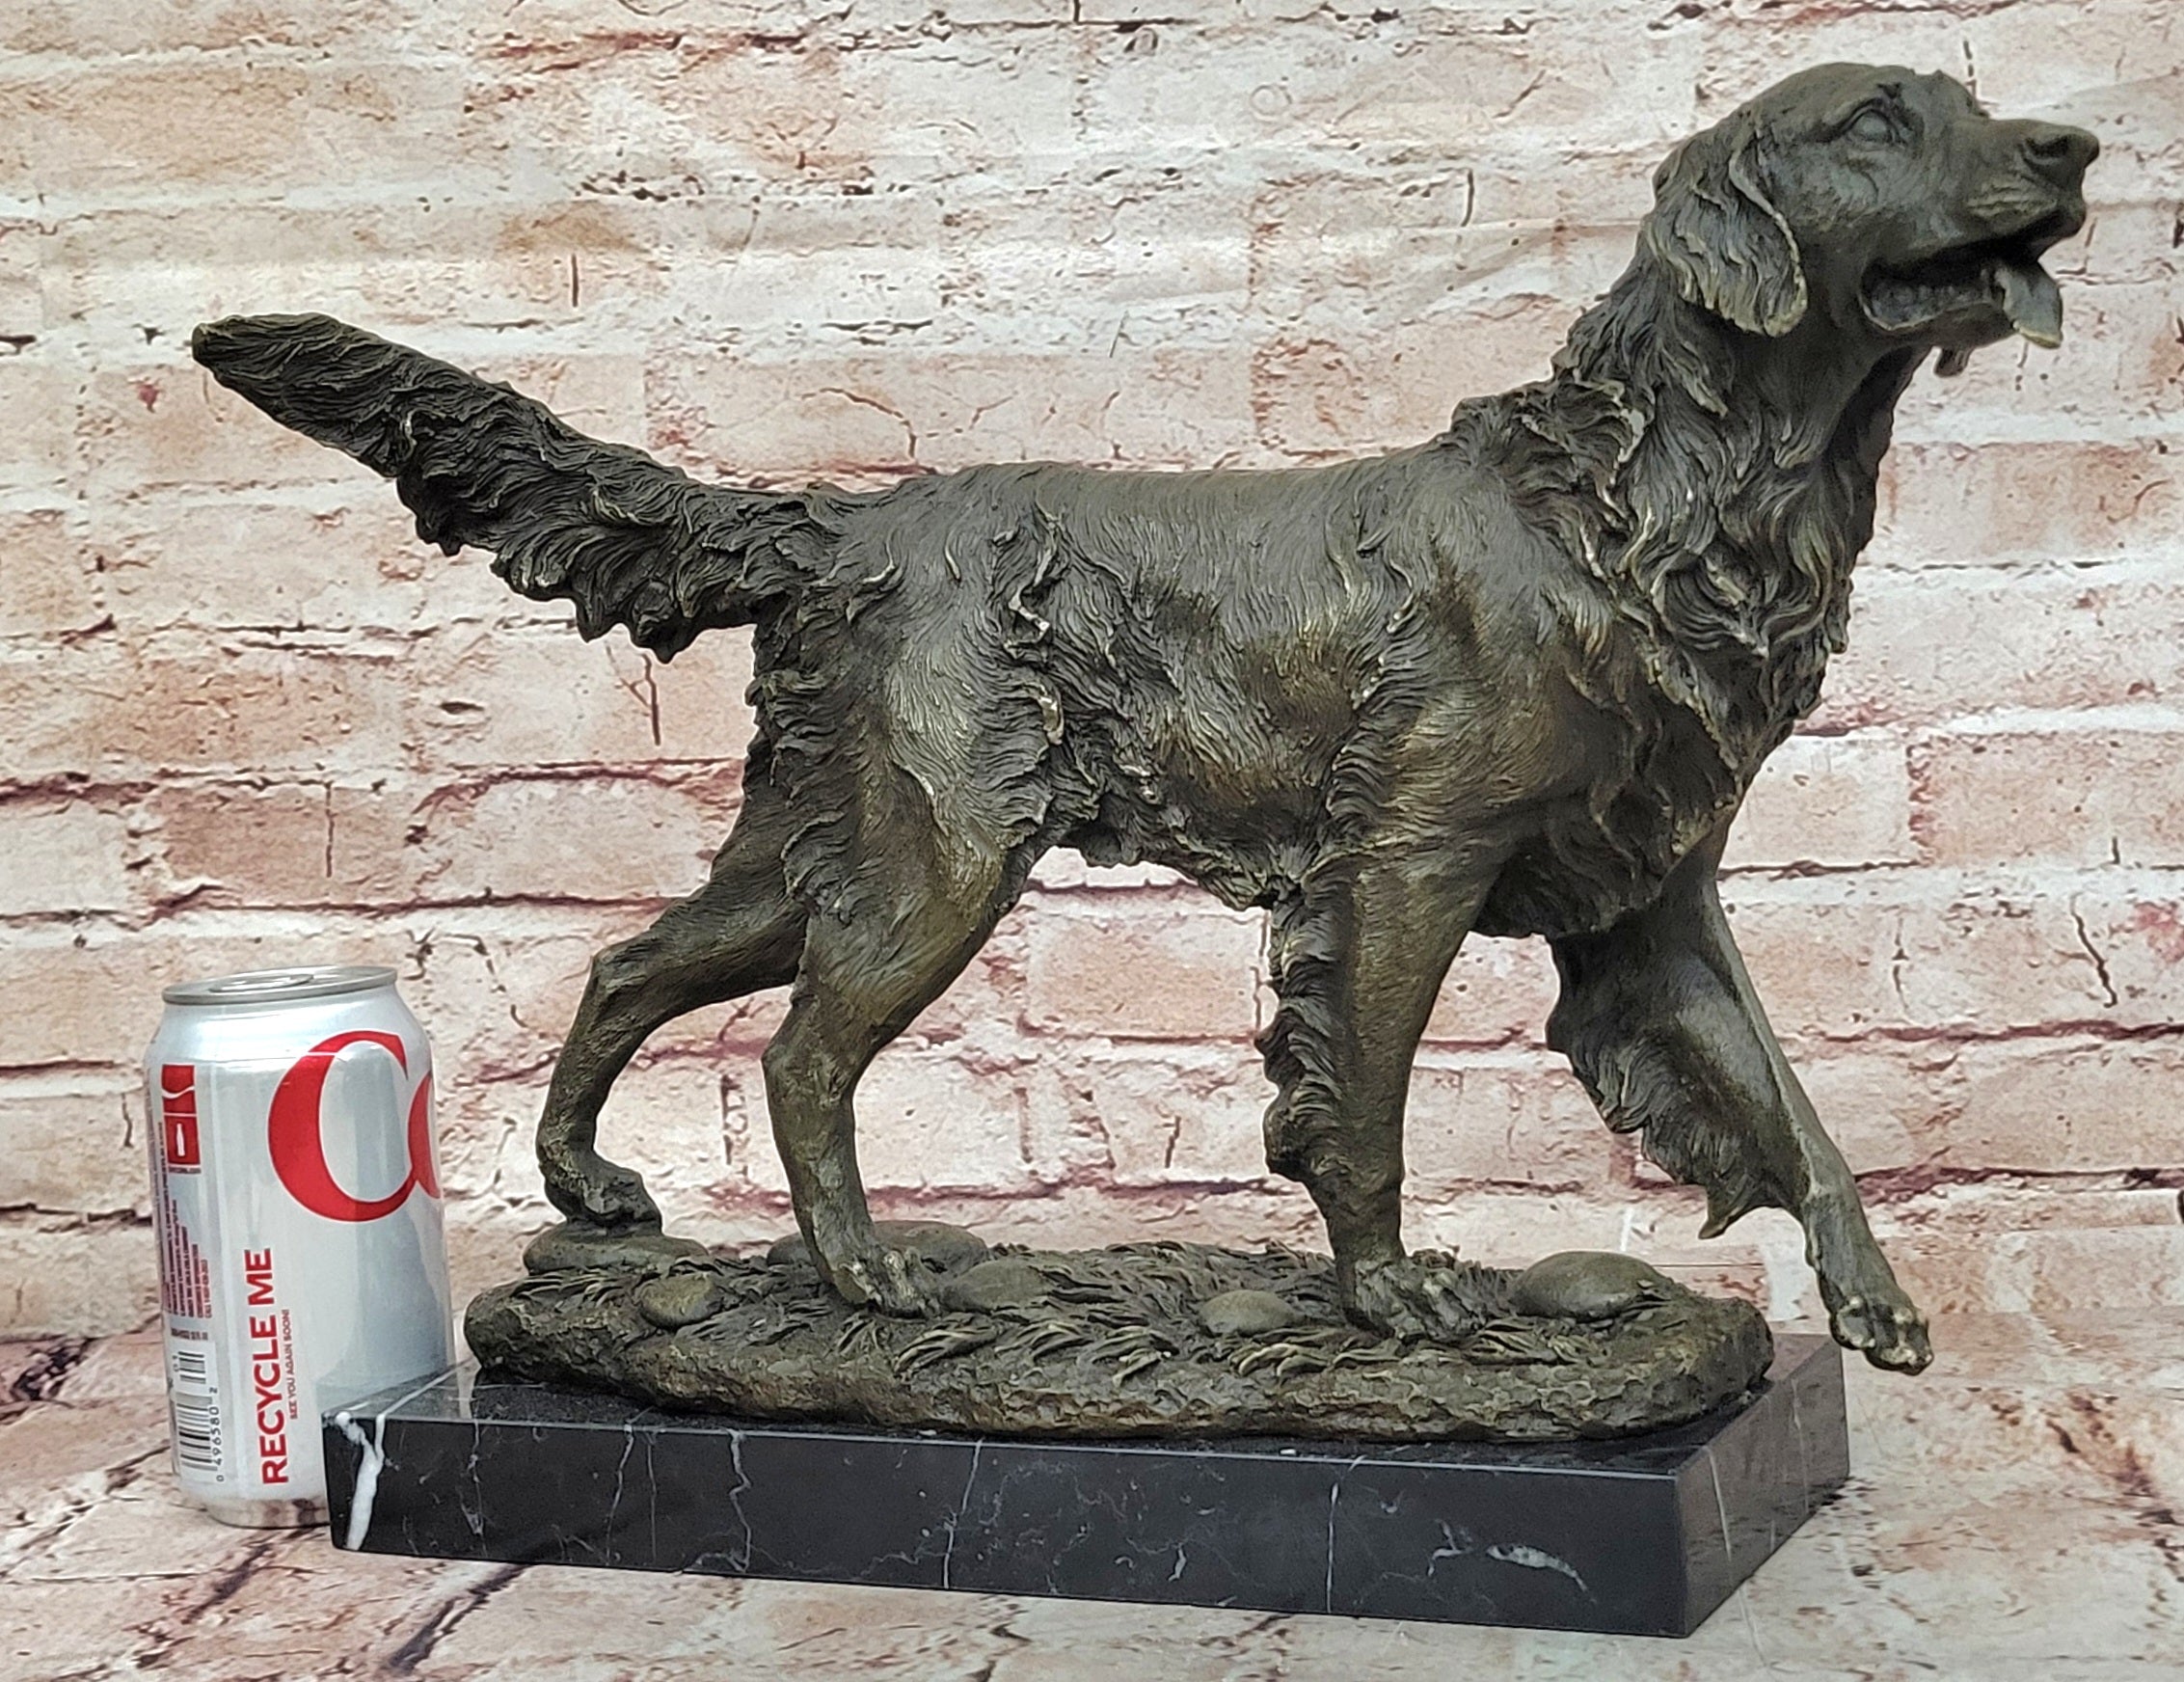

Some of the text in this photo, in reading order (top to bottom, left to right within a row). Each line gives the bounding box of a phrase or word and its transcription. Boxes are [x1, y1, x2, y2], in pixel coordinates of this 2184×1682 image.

[244, 1247, 289, 1484] RECYCLE ME
[281, 1309, 298, 1420] SEE YOU AGAIN SOON!
[208, 1406, 223, 1466] 496580
